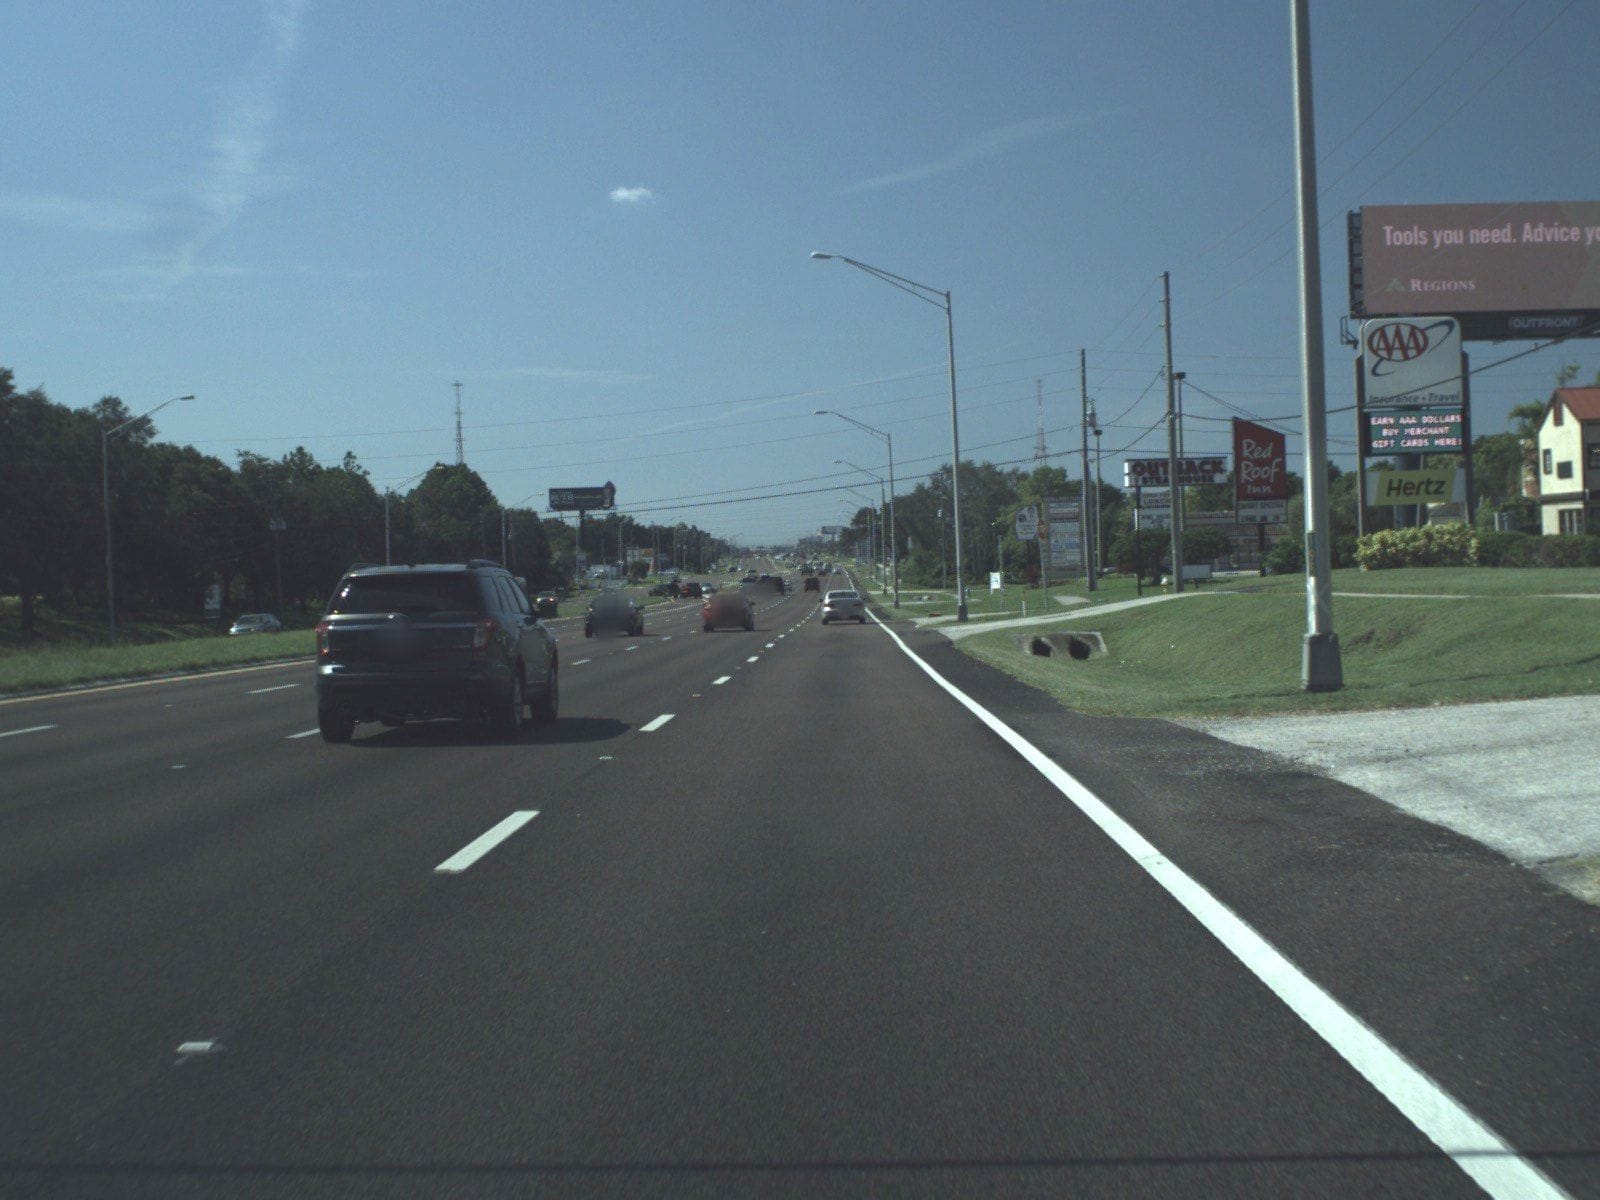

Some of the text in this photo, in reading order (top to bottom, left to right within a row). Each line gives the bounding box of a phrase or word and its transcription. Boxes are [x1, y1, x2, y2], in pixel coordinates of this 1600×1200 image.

[1383, 225, 1428, 246] Tools
[1432, 227, 1464, 249] you
[1469, 223, 1517, 244] need.
[1522, 221, 1581, 242] Advice
[1374, 324, 1425, 360] AAA
[1428, 392, 1460, 402] Travel
[1370, 414, 1462, 425] EARN AAA DOLLARS
[1382, 427, 1450, 437] BUY MERCHANT
[1372, 440, 1395, 448] GIFT
[1400, 438, 1430, 447] CARDS
[1242, 439, 1274, 460] Red
[1240, 457, 1282, 484] Roof
[1141, 474, 1215, 485] STEAHOUSE
[1247, 484, 1272, 494] Inn
[1386, 477, 1447, 497] Hertz
